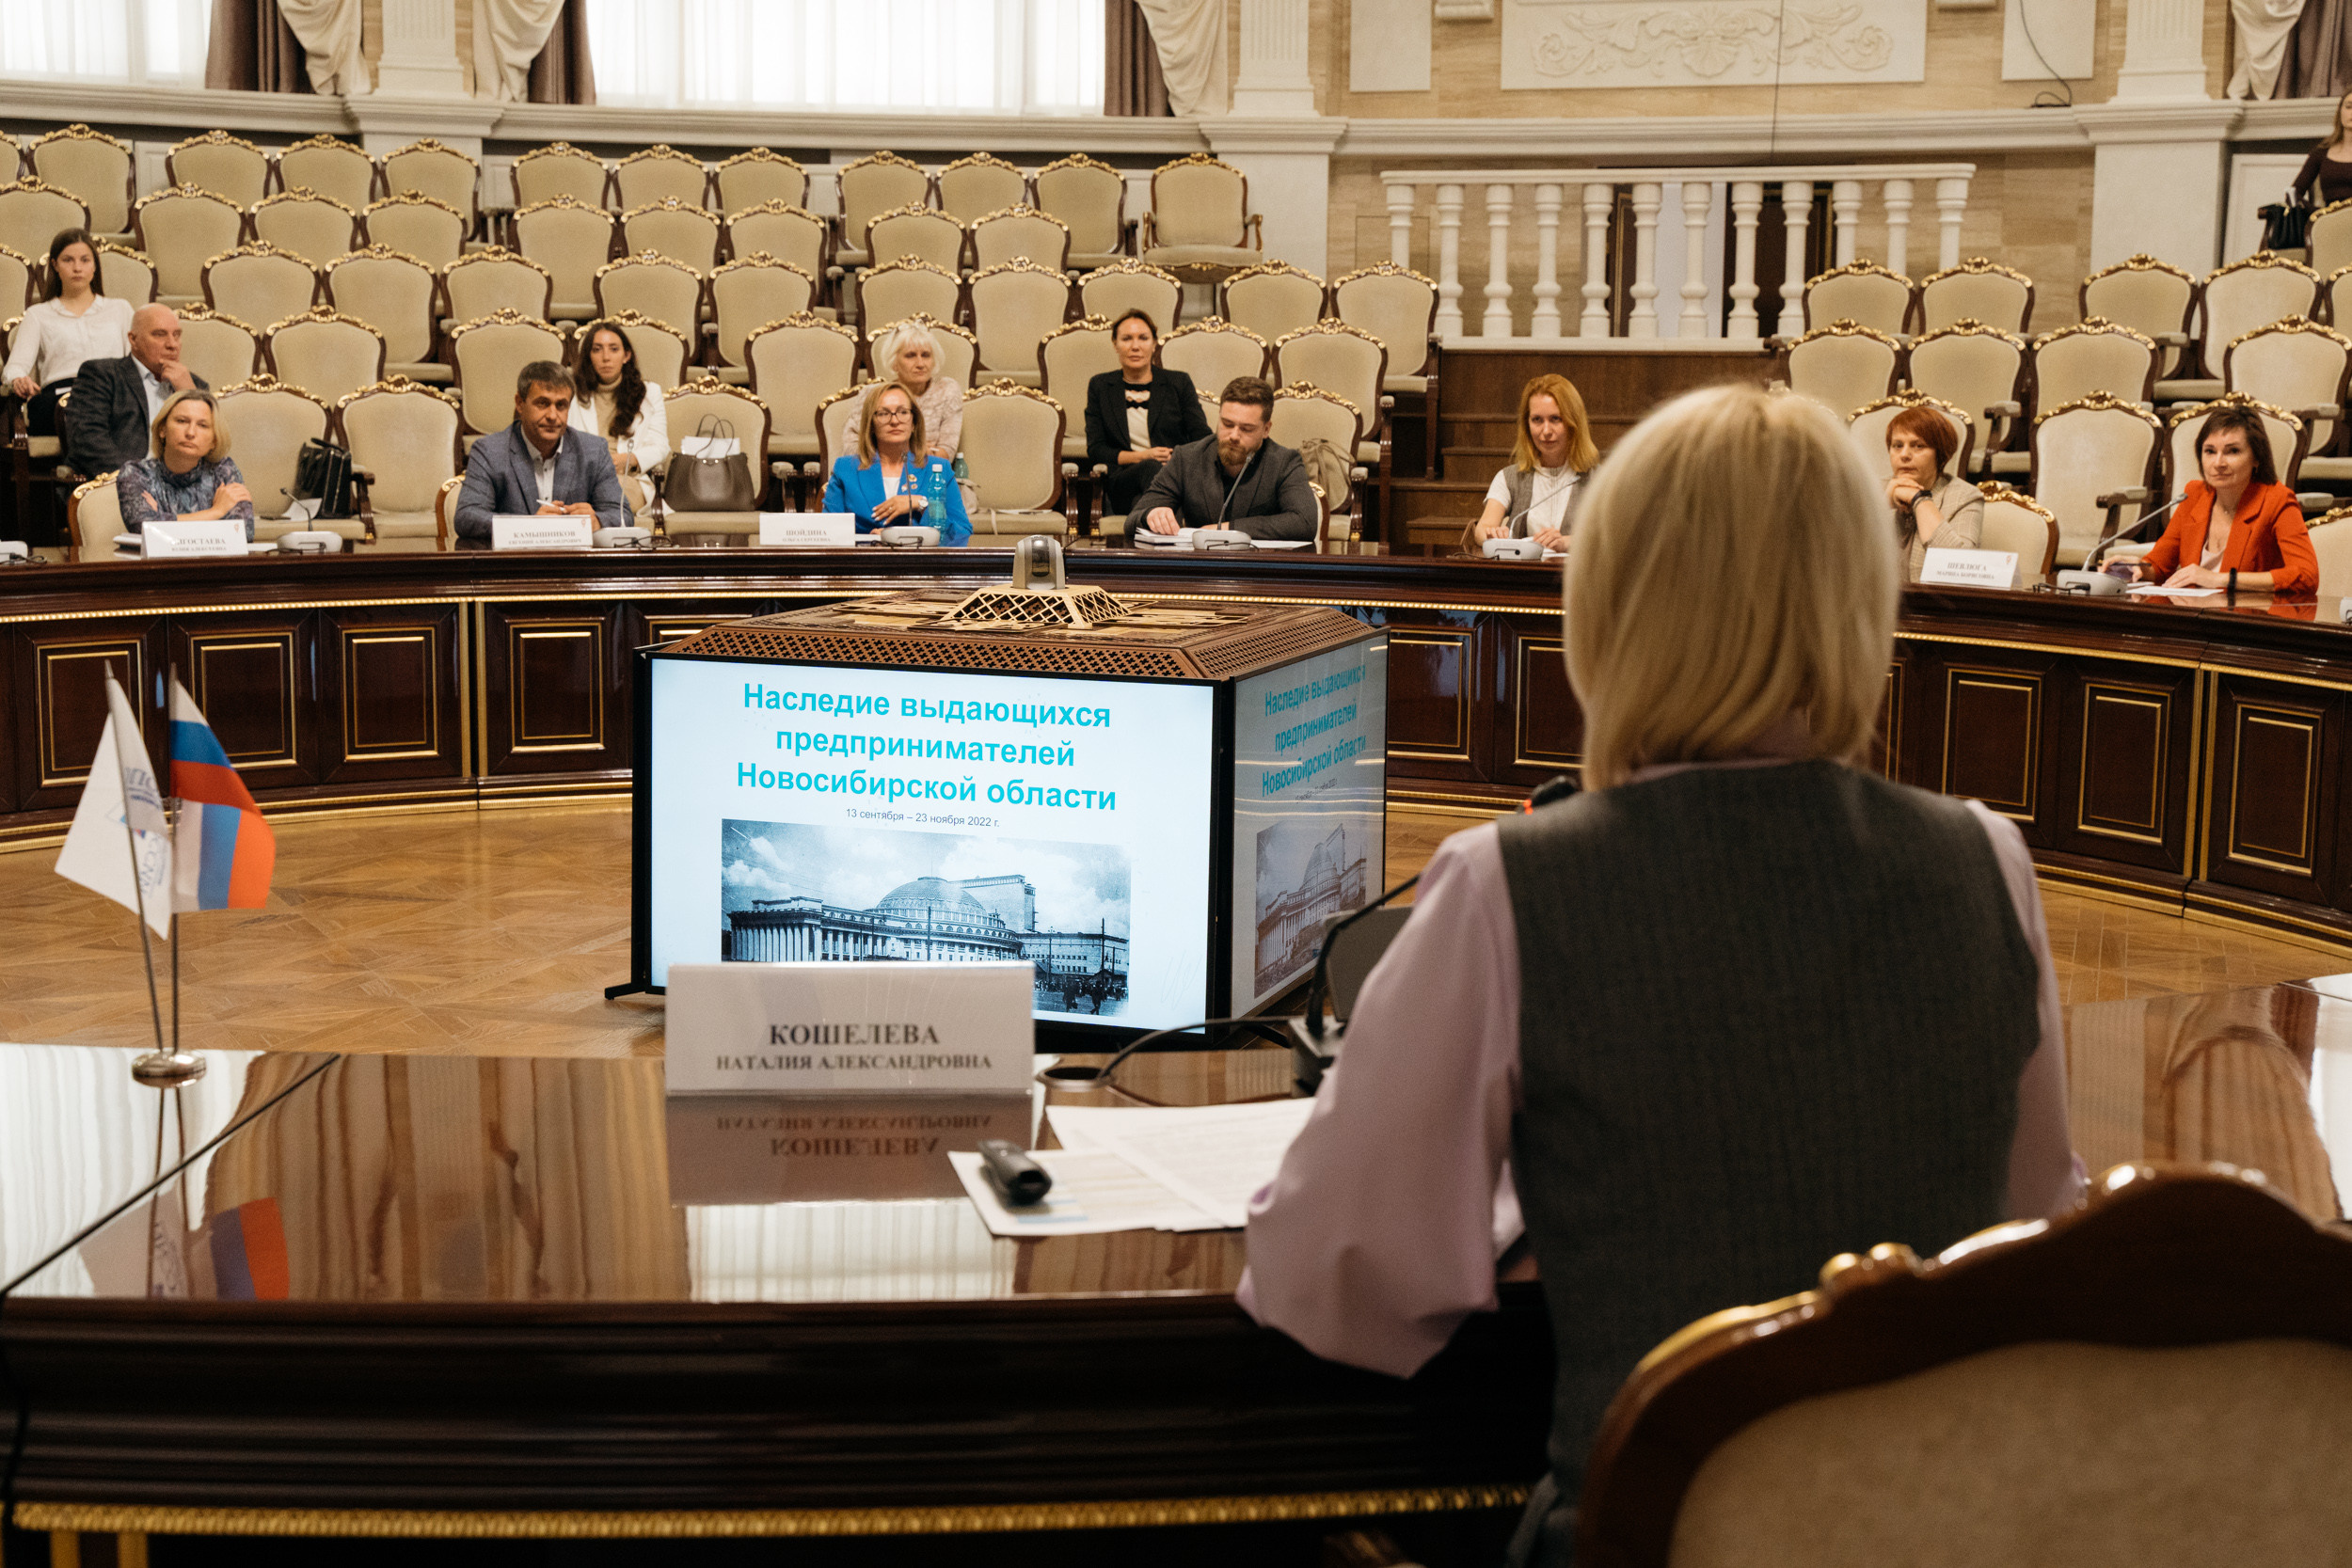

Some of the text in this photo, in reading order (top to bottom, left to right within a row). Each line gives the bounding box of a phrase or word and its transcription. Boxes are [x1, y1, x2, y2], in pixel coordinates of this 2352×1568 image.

[172, 537, 226, 546] ЛГОСТАЕВА
[744, 683, 1110, 729] Наследие выдающихся
[1264, 664, 1366, 717] Наследие выдающихся
[1275, 698, 1357, 756] предпринимателей
[776, 731, 1074, 767] предпринимателей
[1262, 745, 1332, 798] Новосибирской
[1333, 735, 1367, 765] области
[738, 762, 1116, 811] Новосибирской области
[846, 808, 857, 818] 13
[859, 810, 904, 823] сентября
[915, 813, 928, 823] 23
[930, 815, 965, 827] ноября
[967, 816, 992, 827] 2022
[993, 819, 1000, 828] г.
[770, 1023, 940, 1046] КОШЕЛЕВА
[716, 1053, 993, 1070] НАТАЛИЯ АЛЕКСАНДРОВНА
